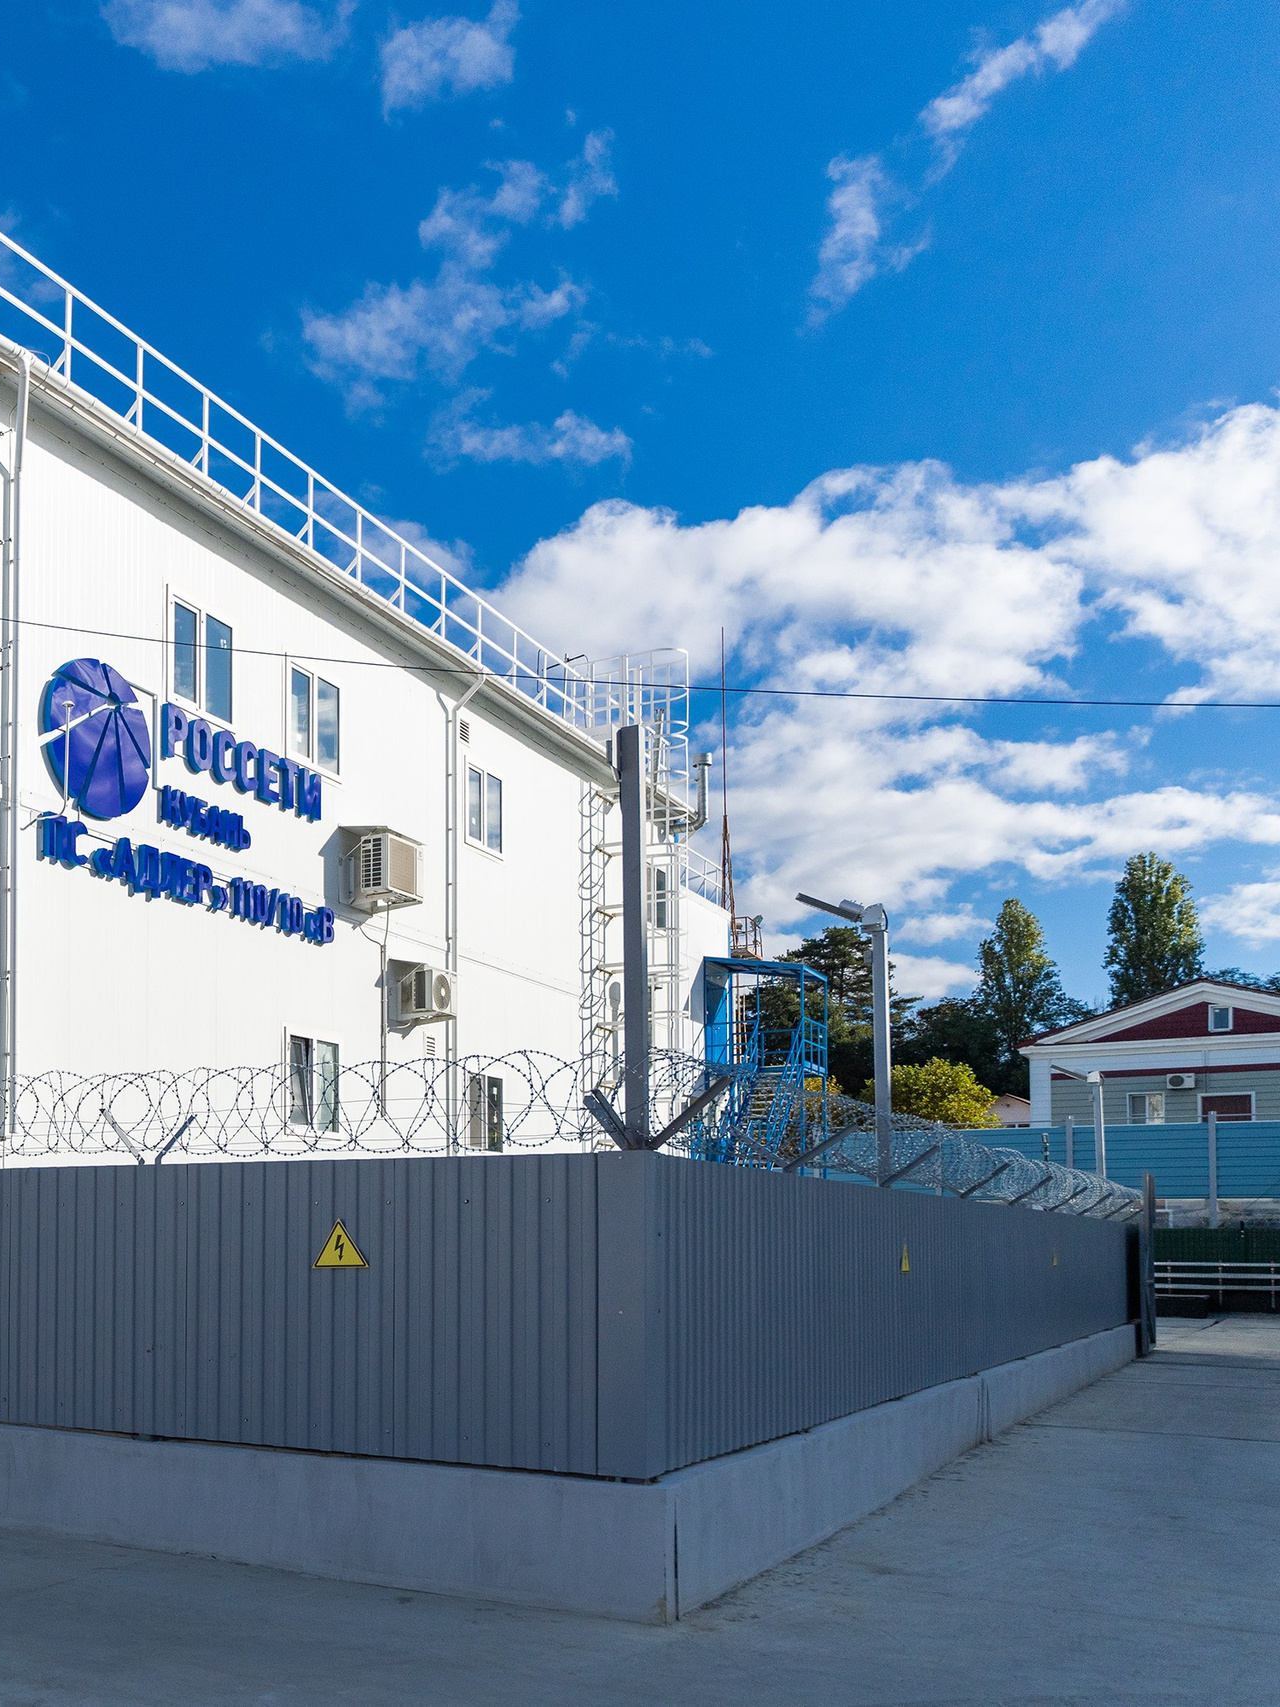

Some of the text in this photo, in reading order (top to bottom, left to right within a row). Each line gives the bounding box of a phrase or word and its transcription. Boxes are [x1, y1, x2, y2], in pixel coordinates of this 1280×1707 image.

[161, 785, 251, 850] КУБАНЬ
[162, 703, 322, 821] РОССЕТИ
[43, 811, 88, 866] ПС
[231, 877, 303, 933] 110/10
